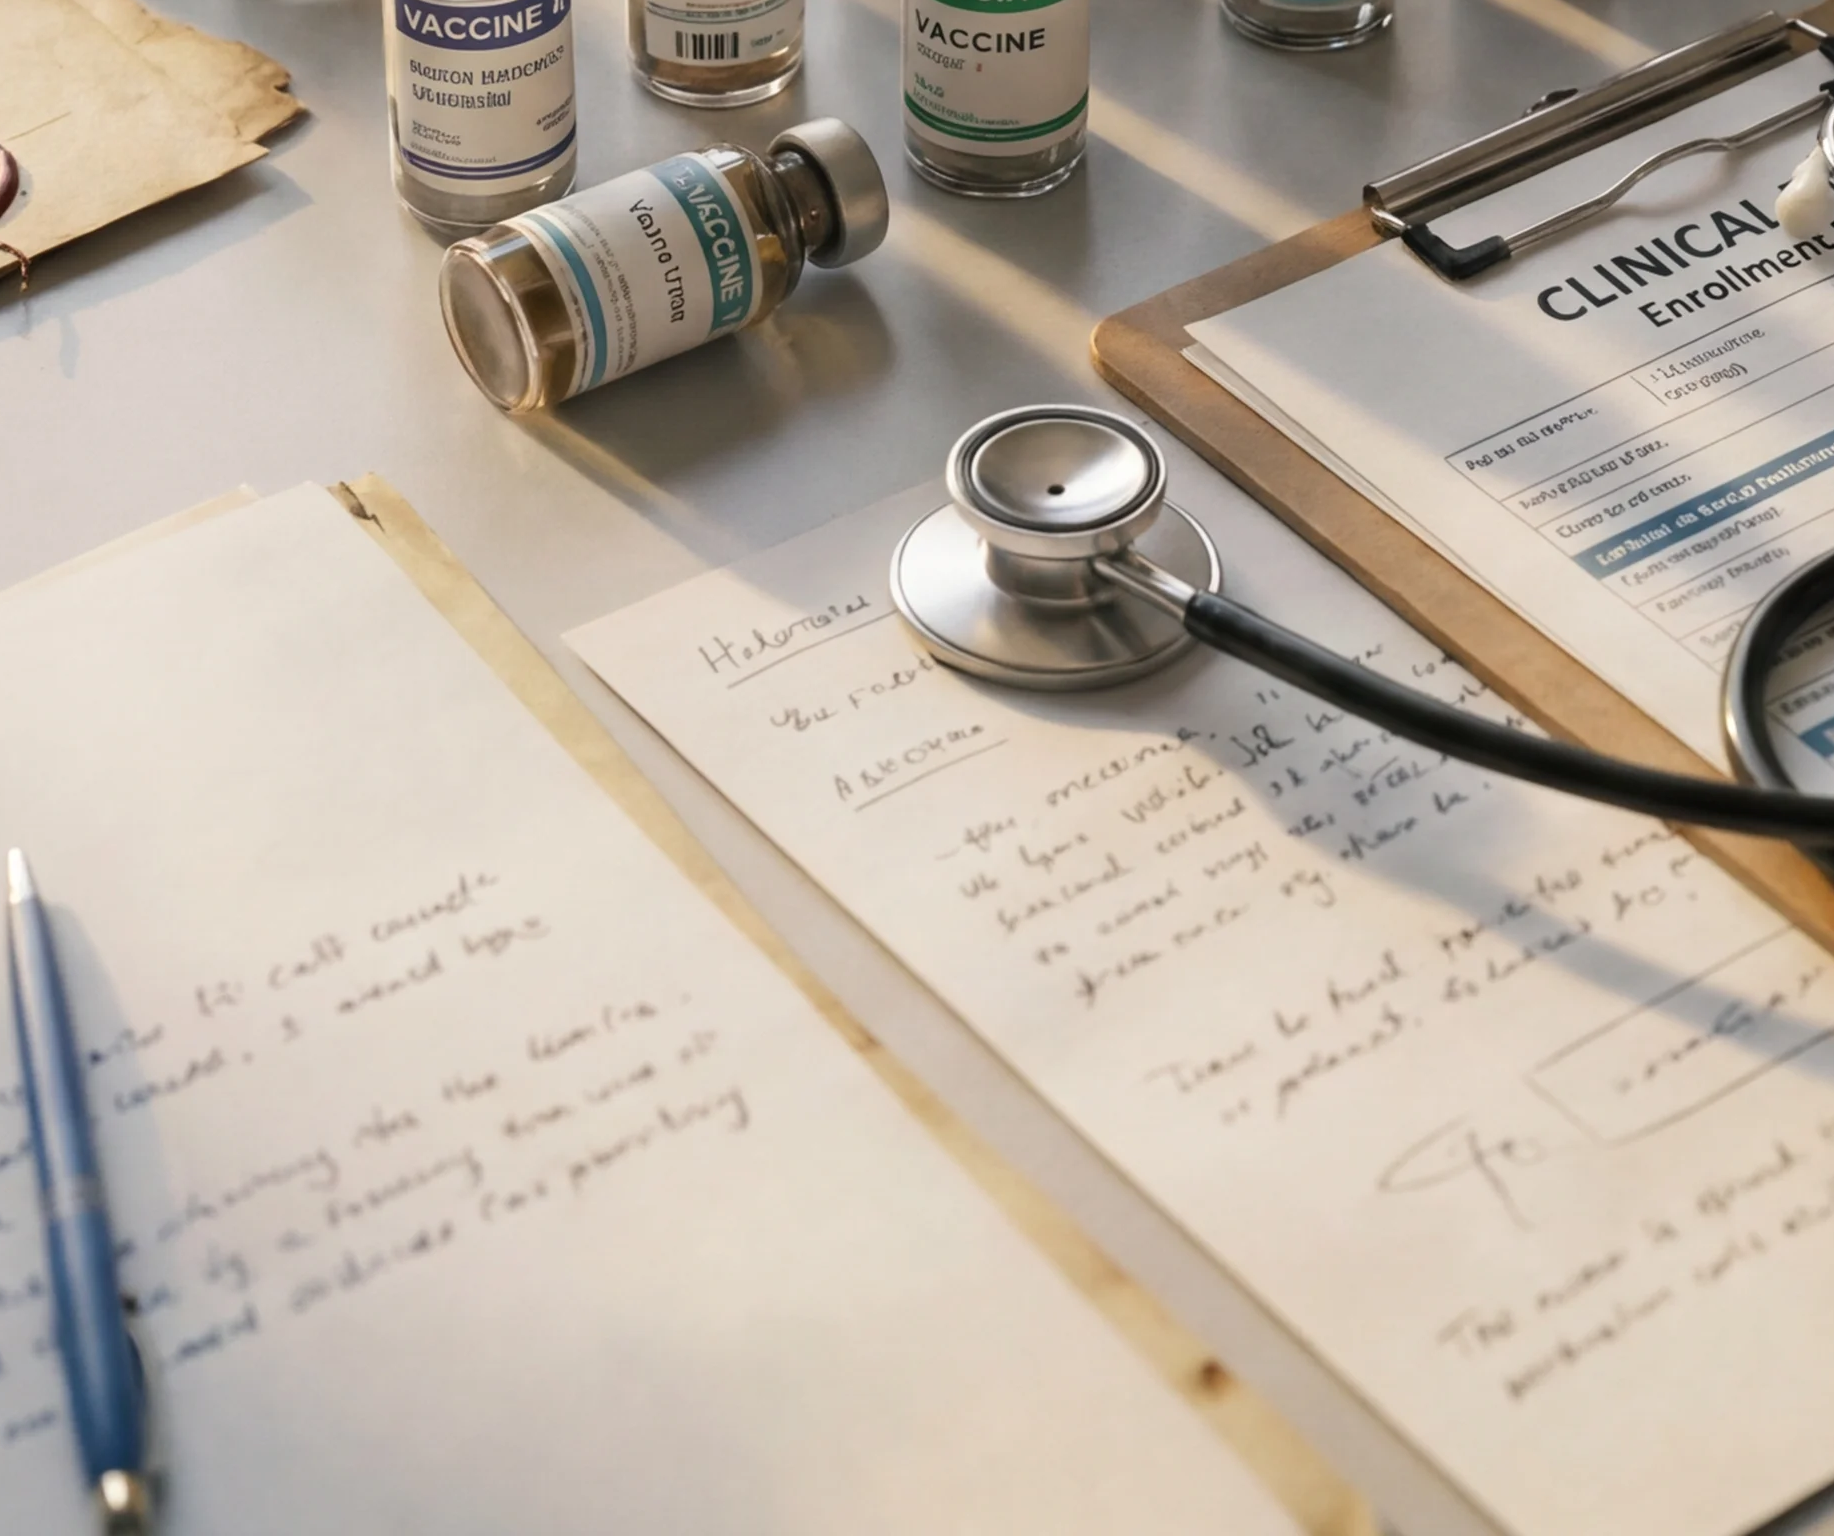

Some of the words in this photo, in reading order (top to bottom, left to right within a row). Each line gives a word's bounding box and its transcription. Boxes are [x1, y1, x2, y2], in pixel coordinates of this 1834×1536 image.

[403, 2, 544, 41] VACCINE
[915, 7, 1046, 54] VACCINE
[1537, 199, 1781, 322] CLINICAL
